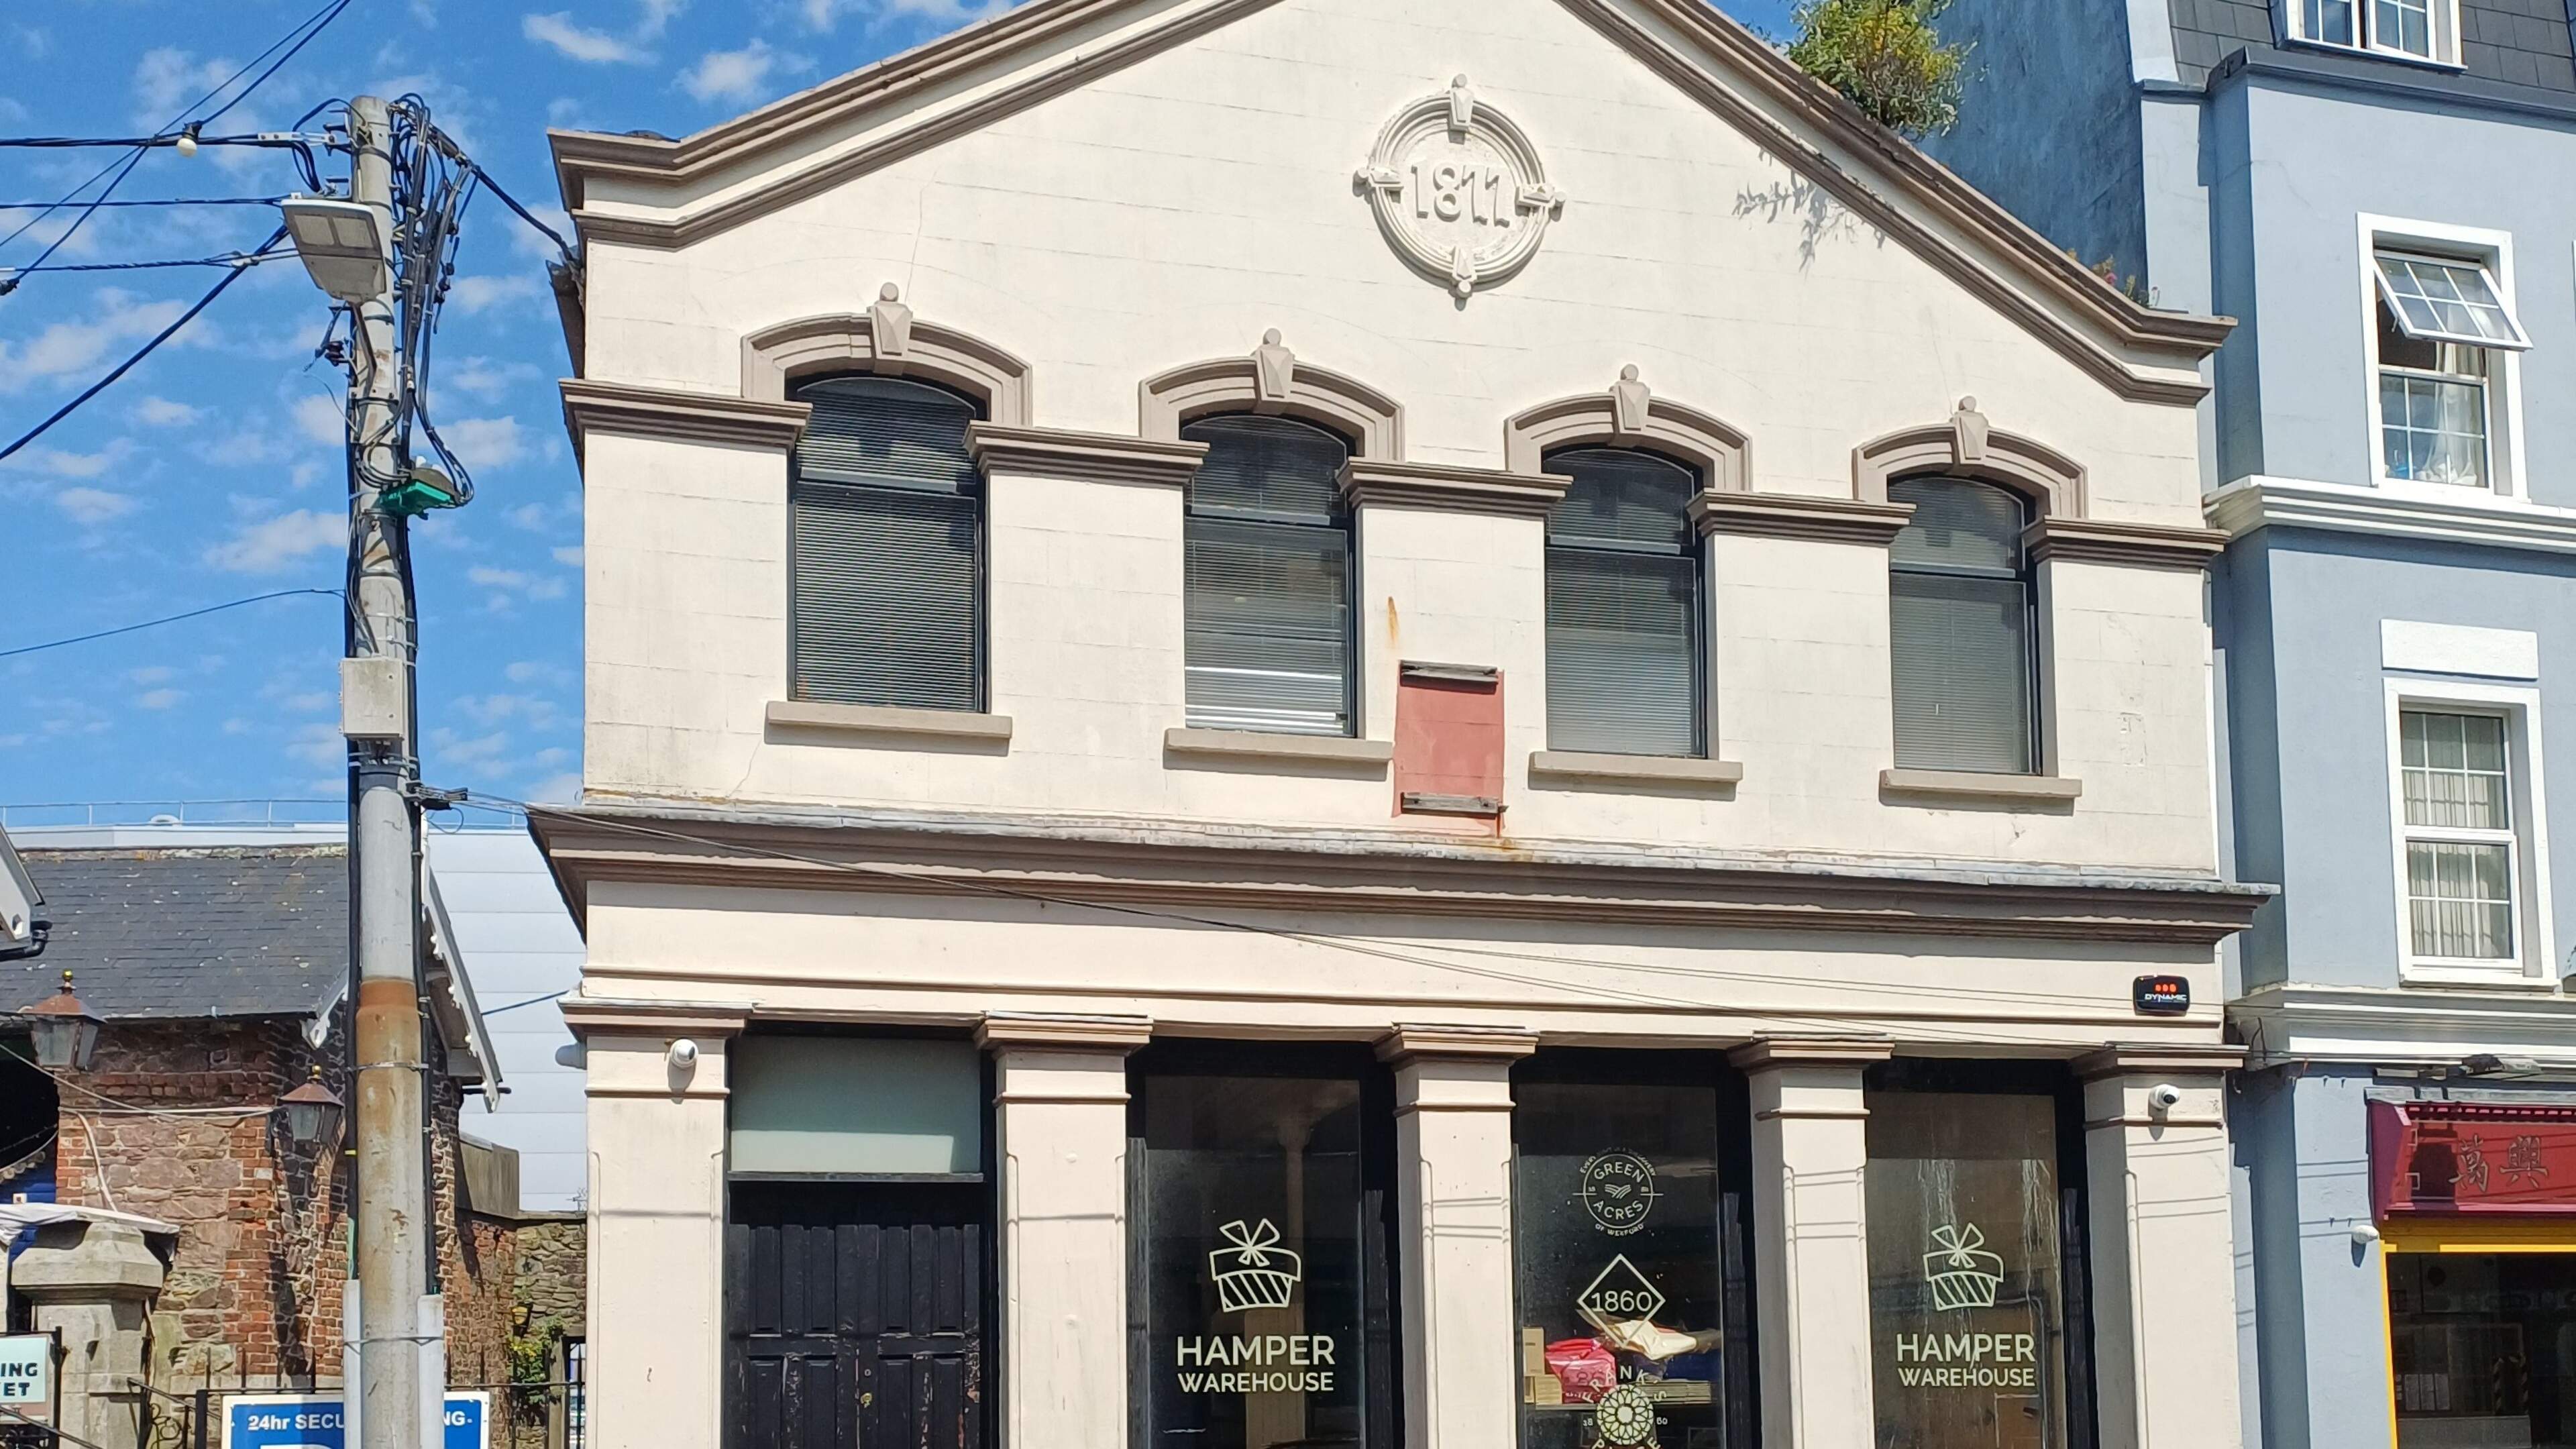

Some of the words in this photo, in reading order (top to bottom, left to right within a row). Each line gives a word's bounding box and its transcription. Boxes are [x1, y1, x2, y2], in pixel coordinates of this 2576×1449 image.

[2145, 994, 2187, 1002] DYNAMIC
[1594, 1161, 1644, 1183] GREEN
[1593, 1200, 1644, 1220] ACRES
[1591, 1291, 1652, 1313] 1860
[1177, 1335, 1335, 1366] HAMPER
[1896, 1333, 2035, 1362] HAMPER
[0, 1362, 38, 1377] ING
[1898, 1368, 2035, 1387] WAREHOUSE
[0, 1382, 30, 1397] ET
[1177, 1373, 1334, 1392] WAREHOUSE
[248, 1415, 290, 1431] 24hr
[295, 1413, 344, 1430] SECU
